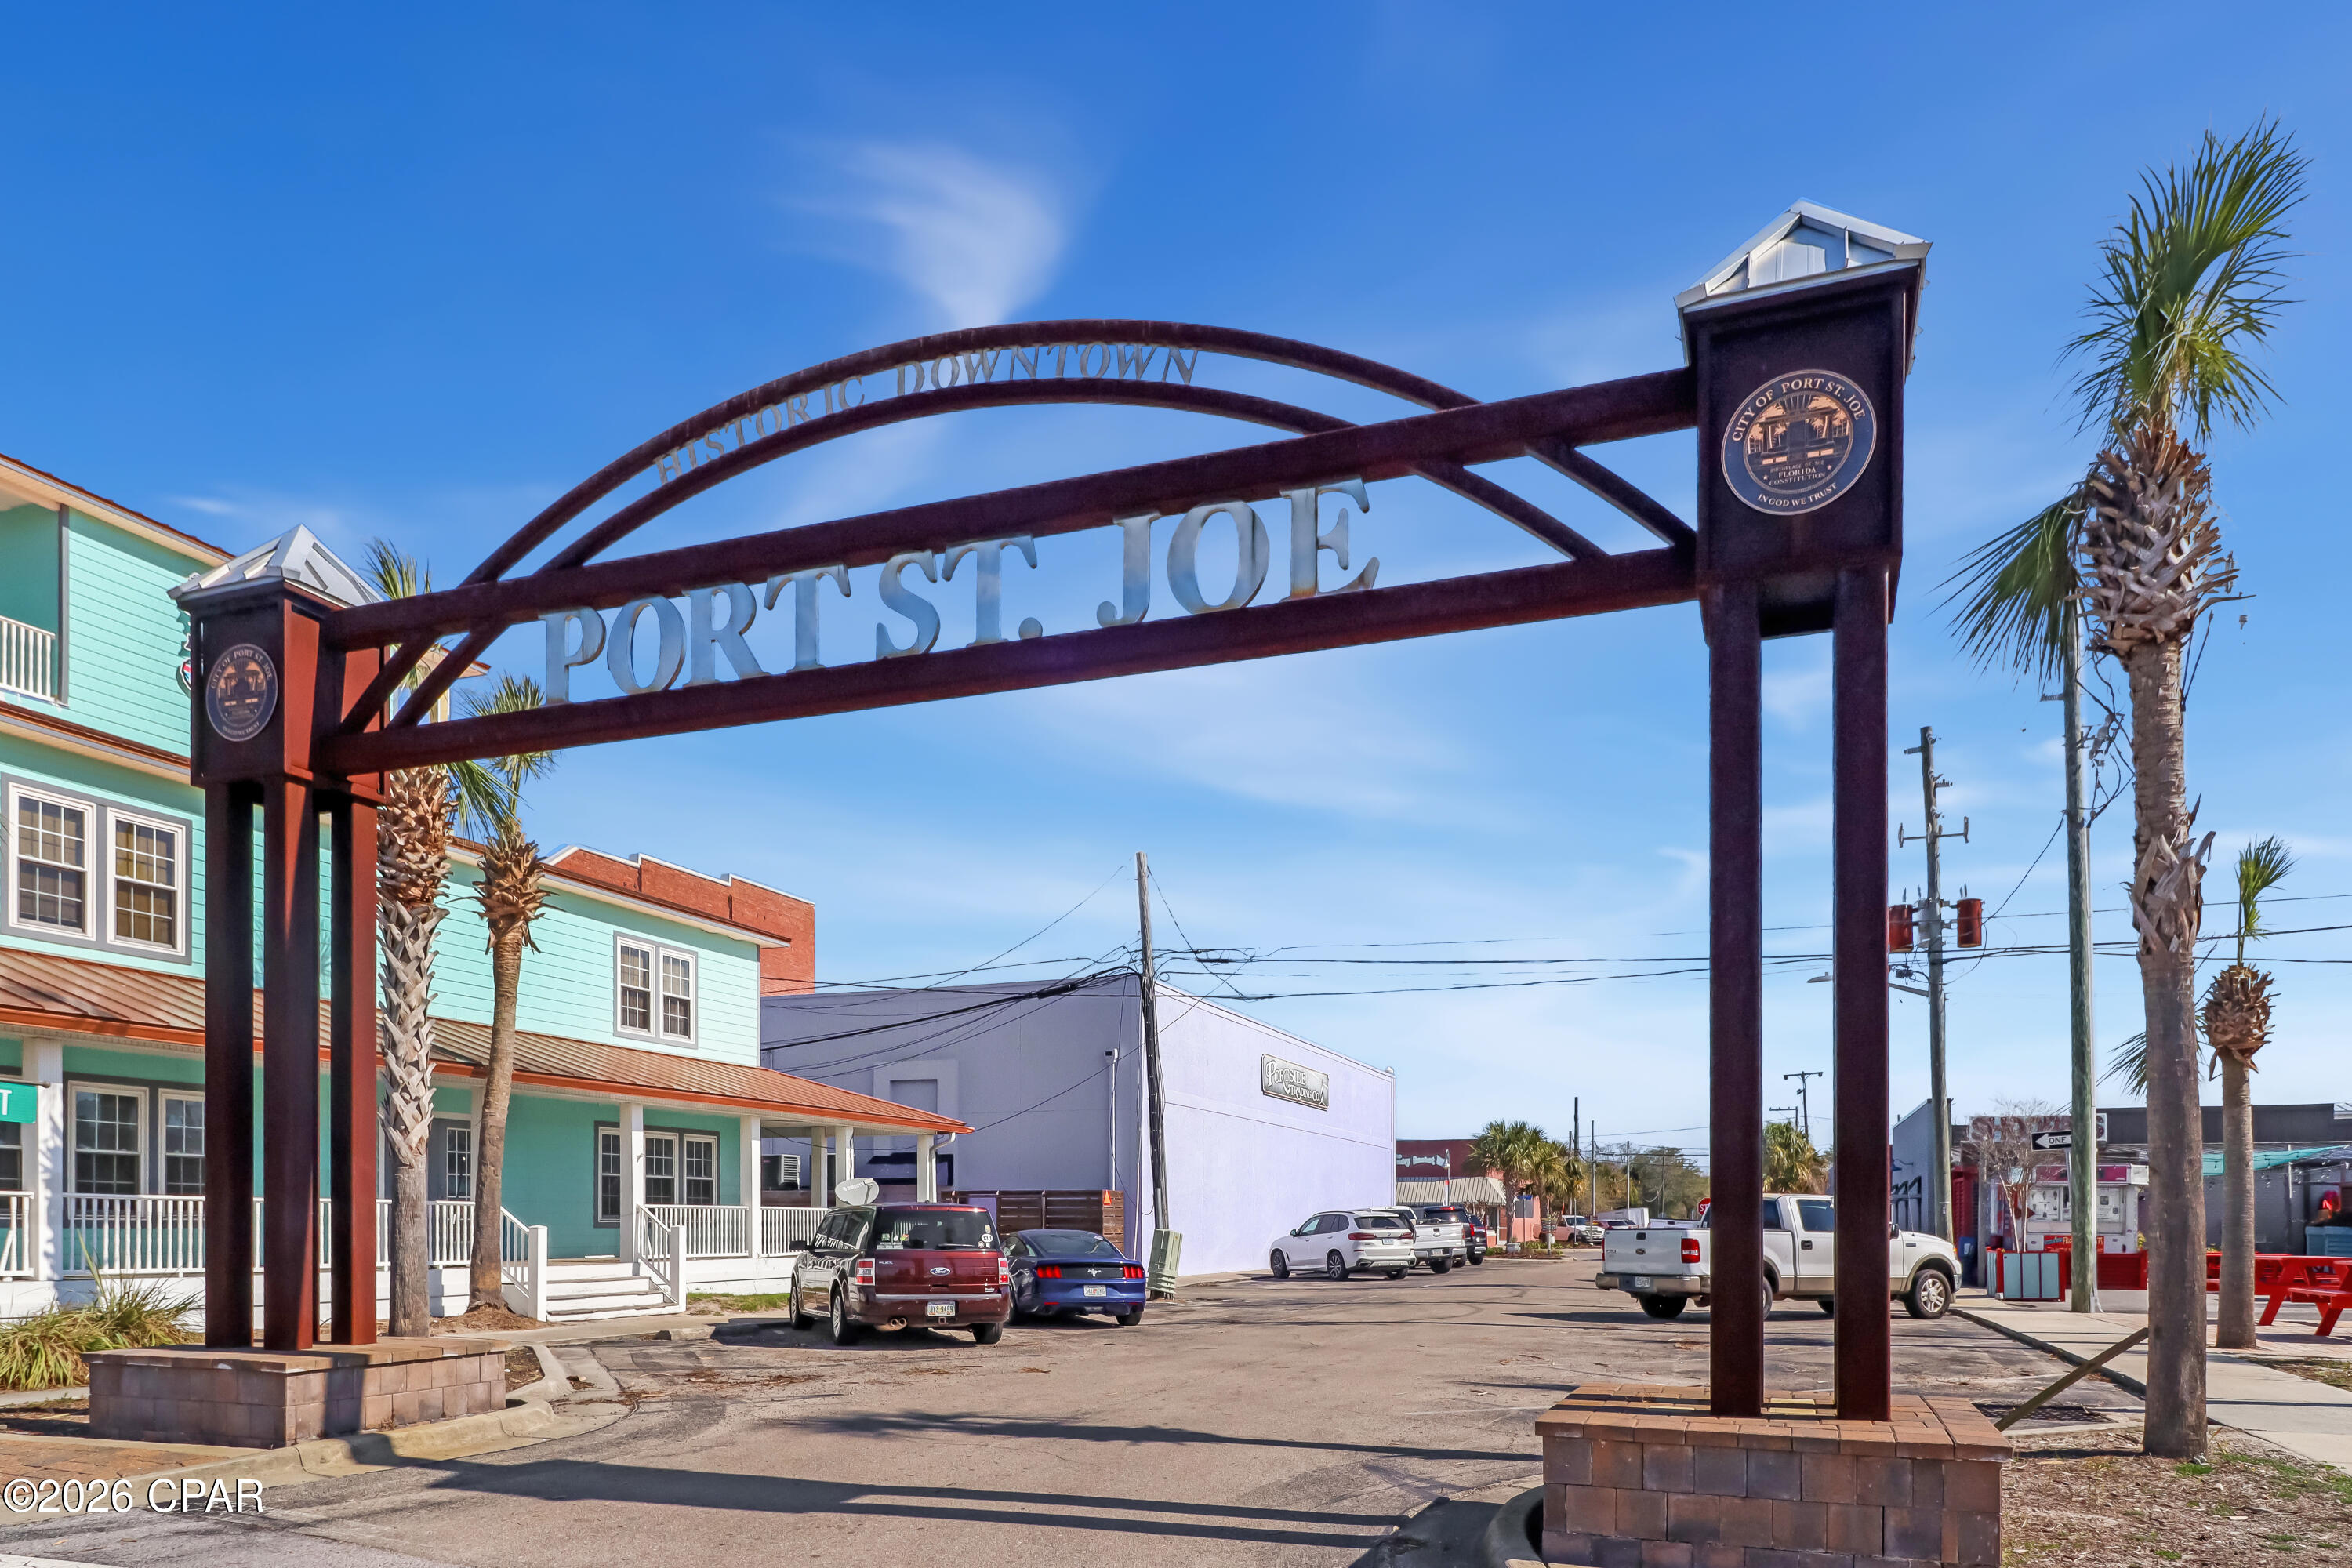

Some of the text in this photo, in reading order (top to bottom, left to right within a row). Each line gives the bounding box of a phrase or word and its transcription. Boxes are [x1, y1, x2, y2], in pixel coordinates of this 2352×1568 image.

[653, 341, 1199, 485] HISTORIC DOWNTOWN
[1732, 378, 1865, 441] CITY OF PORT ST. JOE
[1769, 473, 1825, 485] CONSTITUTION
[1778, 466, 1817, 478] FLORIDA
[1757, 482, 1837, 506] IN GOD WE TRUST
[537, 474, 1381, 706] PORT ST. JOE
